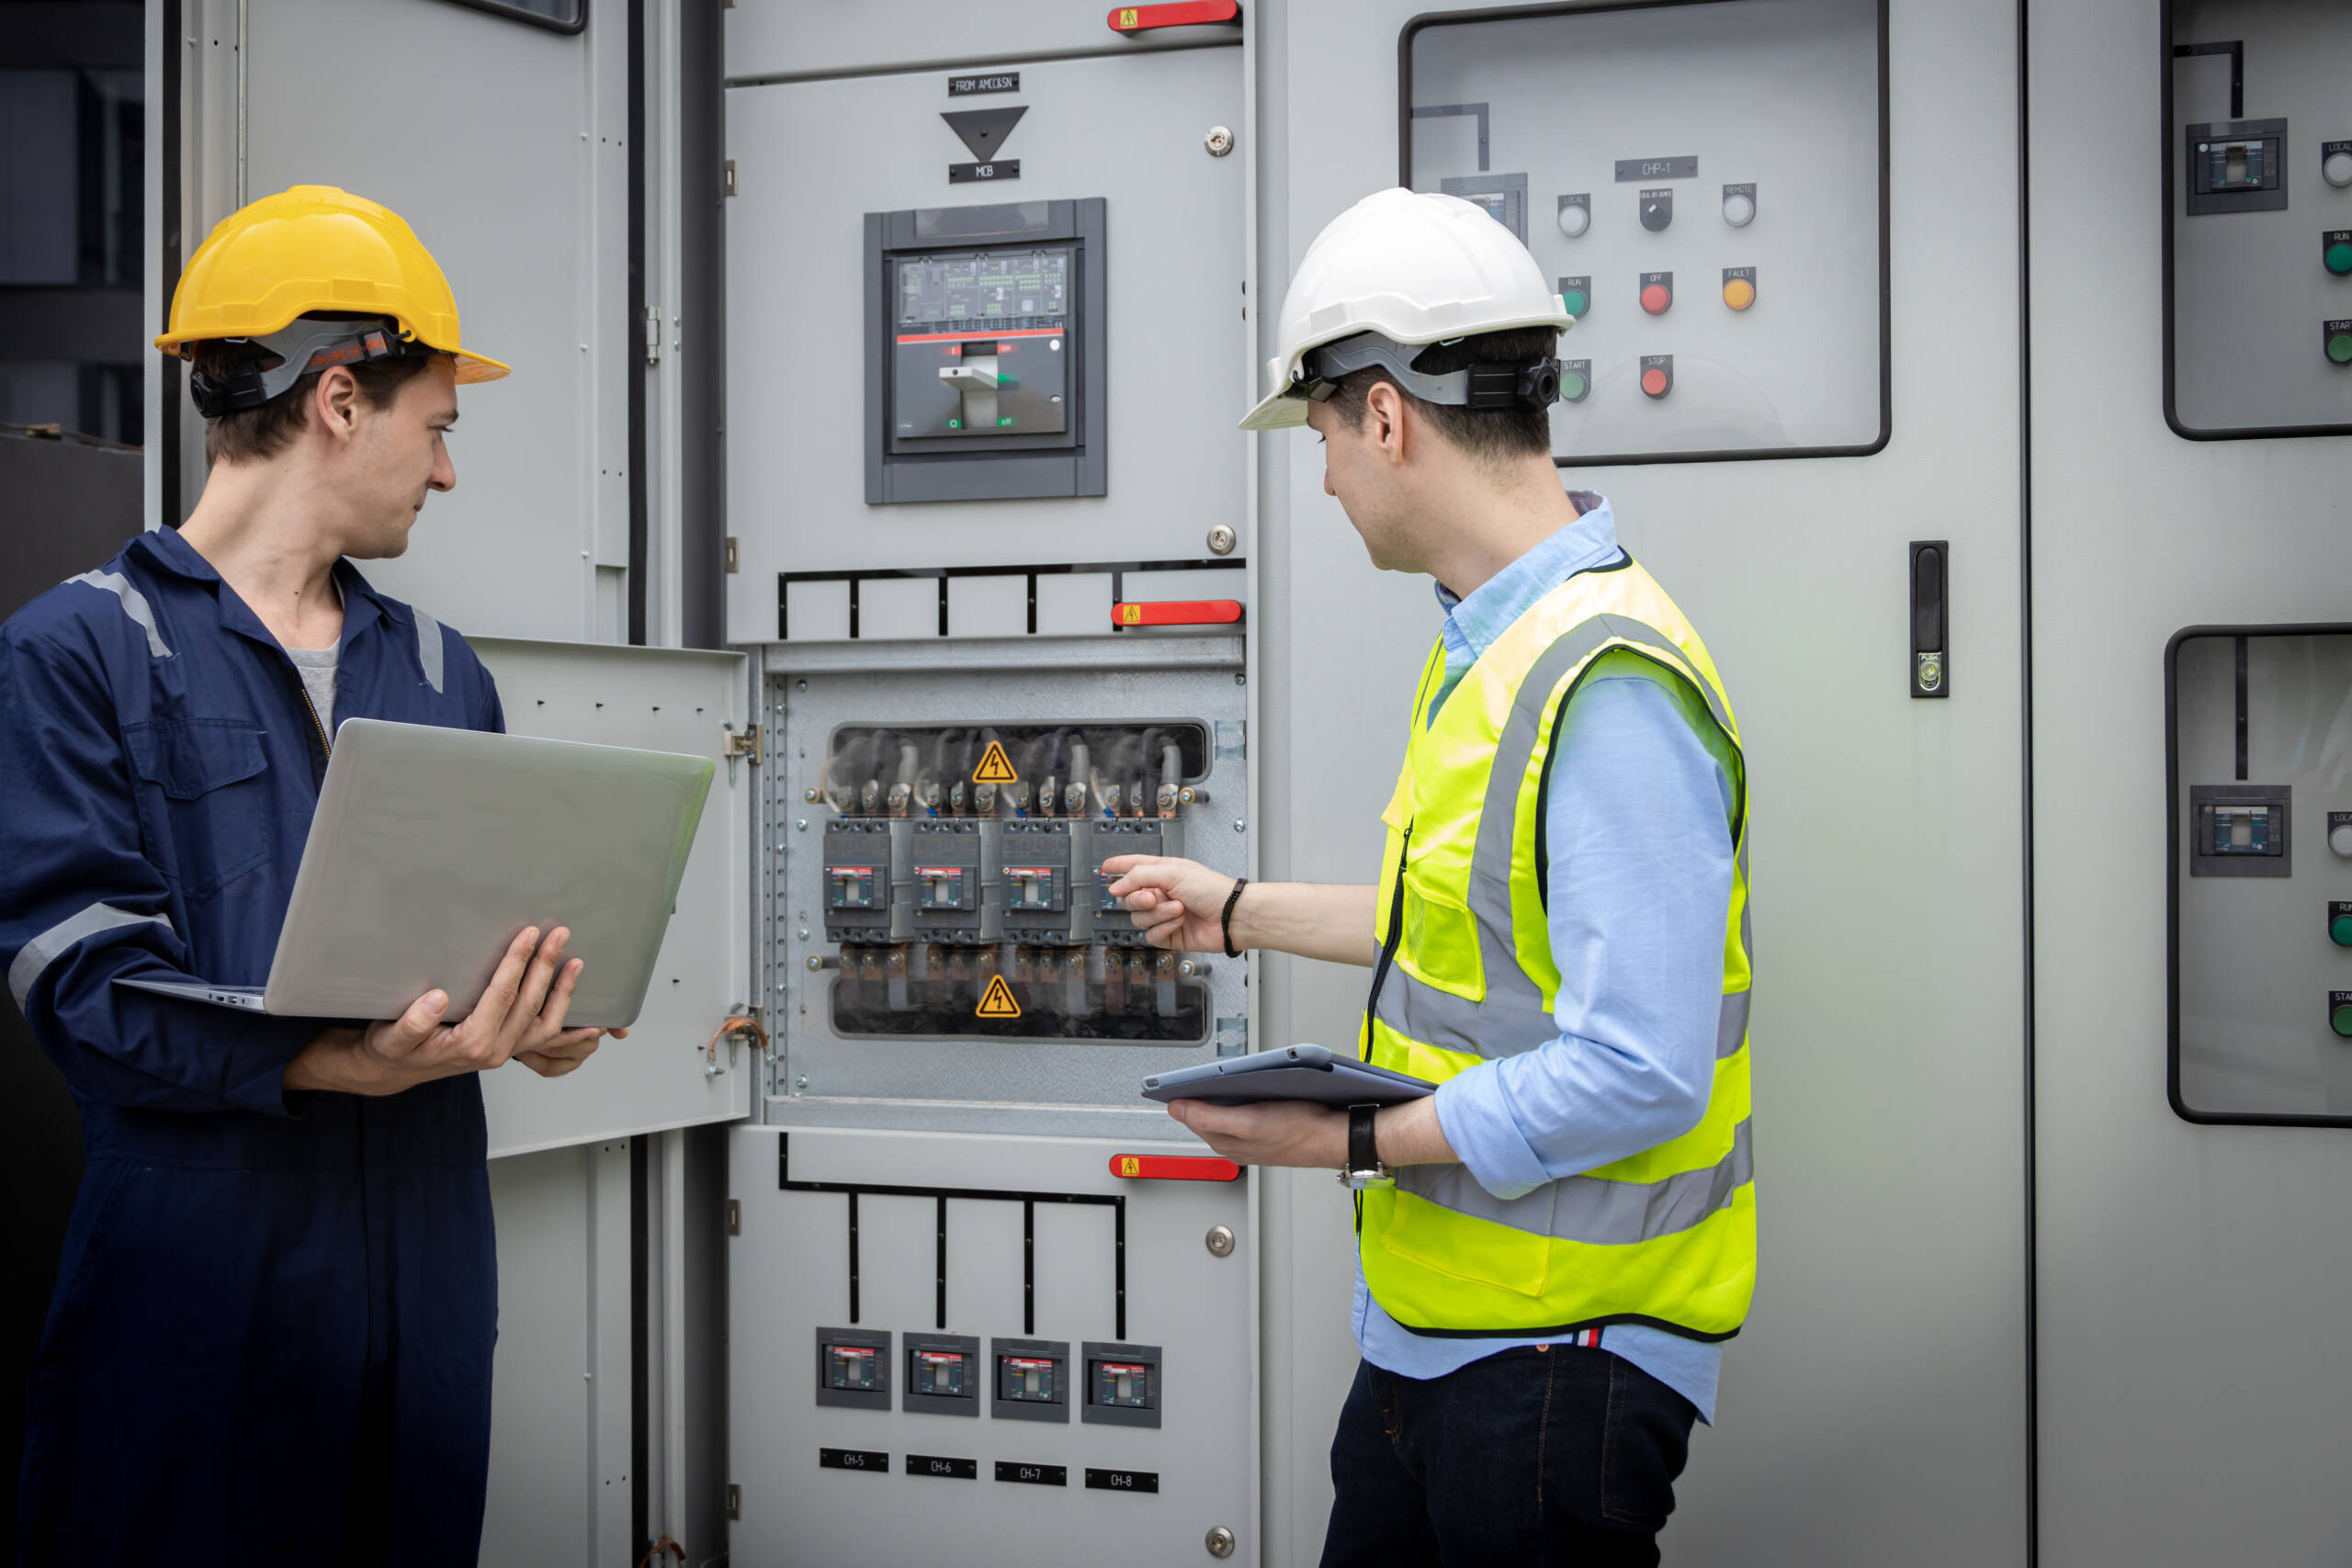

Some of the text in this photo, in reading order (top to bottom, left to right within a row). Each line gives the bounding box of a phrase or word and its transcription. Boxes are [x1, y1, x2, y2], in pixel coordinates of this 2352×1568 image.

[956, 79, 976, 92] FROM
[976, 165, 993, 176] MCB
[1643, 162, 1670, 175] CHP-1
[1564, 196, 1584, 205] LOCAL
[2334, 231, 2350, 242] RUN
[1649, 274, 1662, 282] OFF
[1727, 268, 1749, 278] FAULT
[1567, 278, 1582, 287] RUN
[2330, 320, 2352, 331] STAR
[1564, 360, 1586, 369] START
[1647, 356, 1666, 366] STOP
[1001, 418, 1012, 426] off
[2335, 992, 2352, 1001] STA
[843, 1453, 865, 1467] CH-5
[931, 1460, 952, 1473] CH-6
[1020, 1467, 1041, 1480] CH-7
[1110, 1473, 1132, 1487] CH-8
